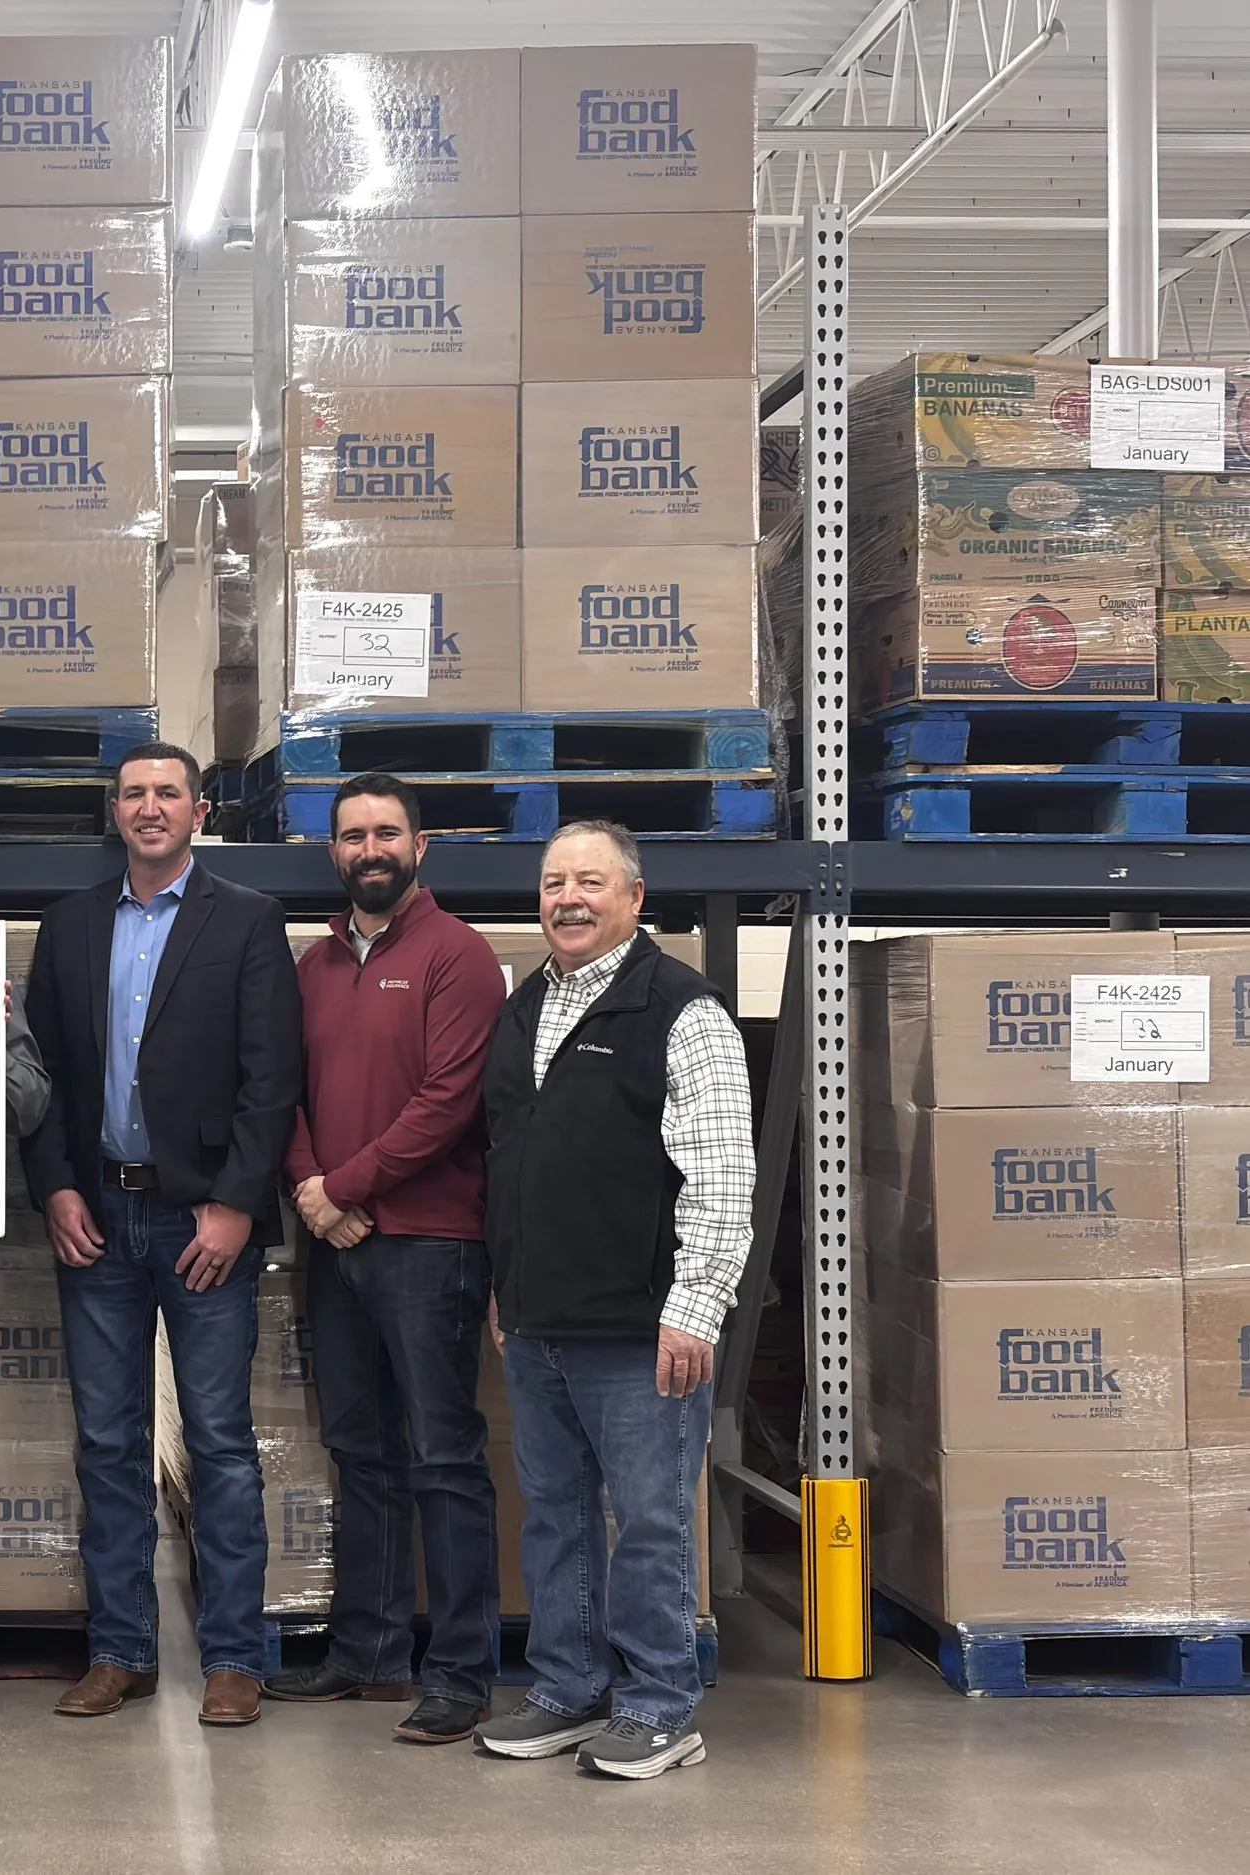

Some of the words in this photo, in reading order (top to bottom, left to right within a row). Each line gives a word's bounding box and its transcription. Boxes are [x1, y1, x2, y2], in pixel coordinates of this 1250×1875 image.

[20, 80, 81, 90] KANSAS
[606, 89, 667, 98] KANSAS
[576, 89, 678, 126] food
[579, 125, 696, 153] bank
[21, 251, 82, 260] KANSAS
[343, 265, 444, 302] food
[585, 270, 703, 299] bank
[346, 300, 462, 329] bank
[604, 298, 705, 334] food
[615, 325, 676, 334] KANSAS
[924, 378, 1007, 394] Premium
[1101, 374, 1211, 392] BAG-LDS001
[924, 400, 1023, 416] BANANAS
[16, 422, 76, 431] KANSAS
[607, 426, 668, 435] KANSAS
[363, 433, 423, 442] KANSAS
[578, 426, 680, 463] food
[334, 433, 435, 470] food
[1123, 446, 1189, 464] January
[336, 468, 453, 497] bank
[581, 462, 698, 490] bank
[959, 540, 1039, 554] ORGANIC
[929, 573, 963, 581] FRAGILE
[4, 585, 64, 594] KANSAS
[607, 584, 668, 593] KANSAS
[322, 602, 403, 618] F4K-2425
[578, 584, 680, 620] food
[581, 620, 698, 648] bank
[359, 633, 392, 656] 32
[326, 672, 393, 690] January
[931, 680, 991, 689] PREMIUM
[1090, 680, 1148, 690] BANANAS
[1014, 981, 1070, 990] KANSA
[1098, 985, 1182, 1001] F4K-2425
[1132, 1018, 1162, 1039] 32
[583, 1043, 613, 1054] Columbia
[1105, 1057, 1174, 1075] January
[1021, 1147, 1084, 1157] KANSAS
[991, 1147, 1096, 1186] food
[995, 1184, 1116, 1214] bank
[1026, 1328, 1090, 1337] KANSAS
[996, 1328, 1102, 1366] food
[1000, 1364, 1121, 1394] bank
[1032, 1496, 1095, 1506] KANSAS
[1002, 1496, 1107, 1535] food
[1005, 1533, 1126, 1563] bank
